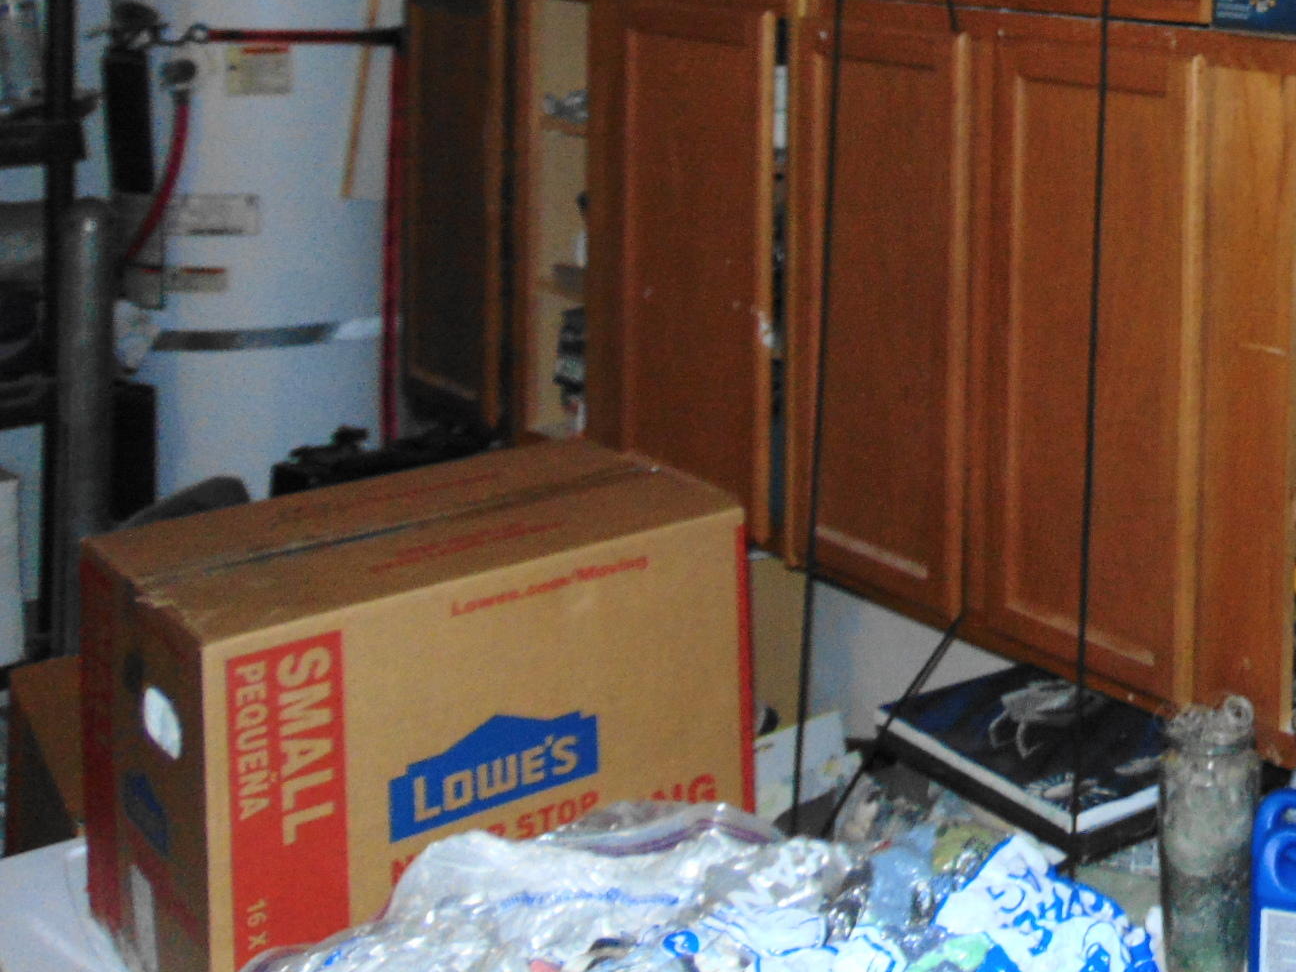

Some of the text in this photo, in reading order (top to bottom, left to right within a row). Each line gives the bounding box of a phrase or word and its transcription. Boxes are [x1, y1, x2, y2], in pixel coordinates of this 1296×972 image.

[234, 659, 278, 822] PEQUEÑA
[276, 646, 336, 846] SMALL
[412, 734, 580, 824] LOWE'S
[515, 790, 601, 841] STOP
[246, 898, 268, 927] 16
